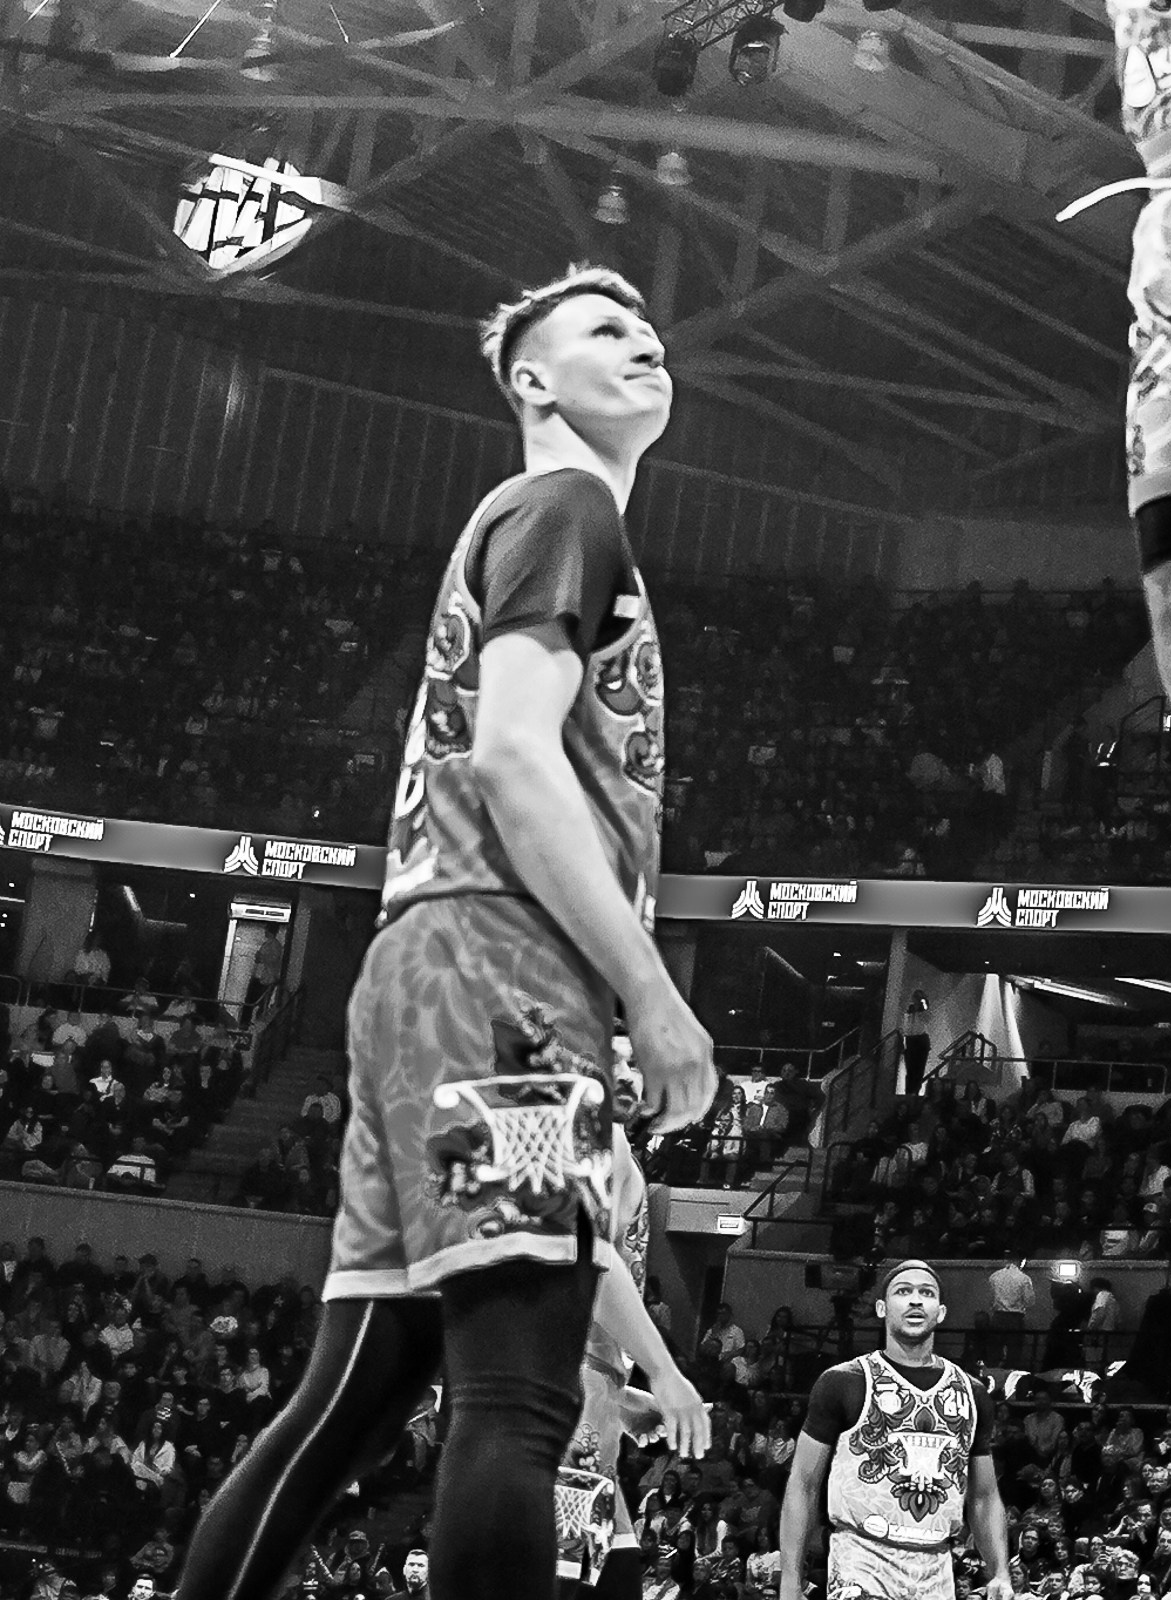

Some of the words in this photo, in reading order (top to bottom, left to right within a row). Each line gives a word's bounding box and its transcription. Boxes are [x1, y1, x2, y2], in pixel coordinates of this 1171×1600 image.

[11, 811, 103, 840] МОСКОВСКИЙ
[8, 832, 52, 851] СПОРТ
[264, 841, 356, 866] МОСКОВСКИЙ
[261, 859, 305, 879] СПОРТ
[770, 881, 857, 903] МОСКОВСКИЙ
[1017, 888, 1109, 910] МОСКОВСКИЙ
[767, 902, 809, 919] СПОРТ
[1015, 909, 1059, 927] СПОРТ
